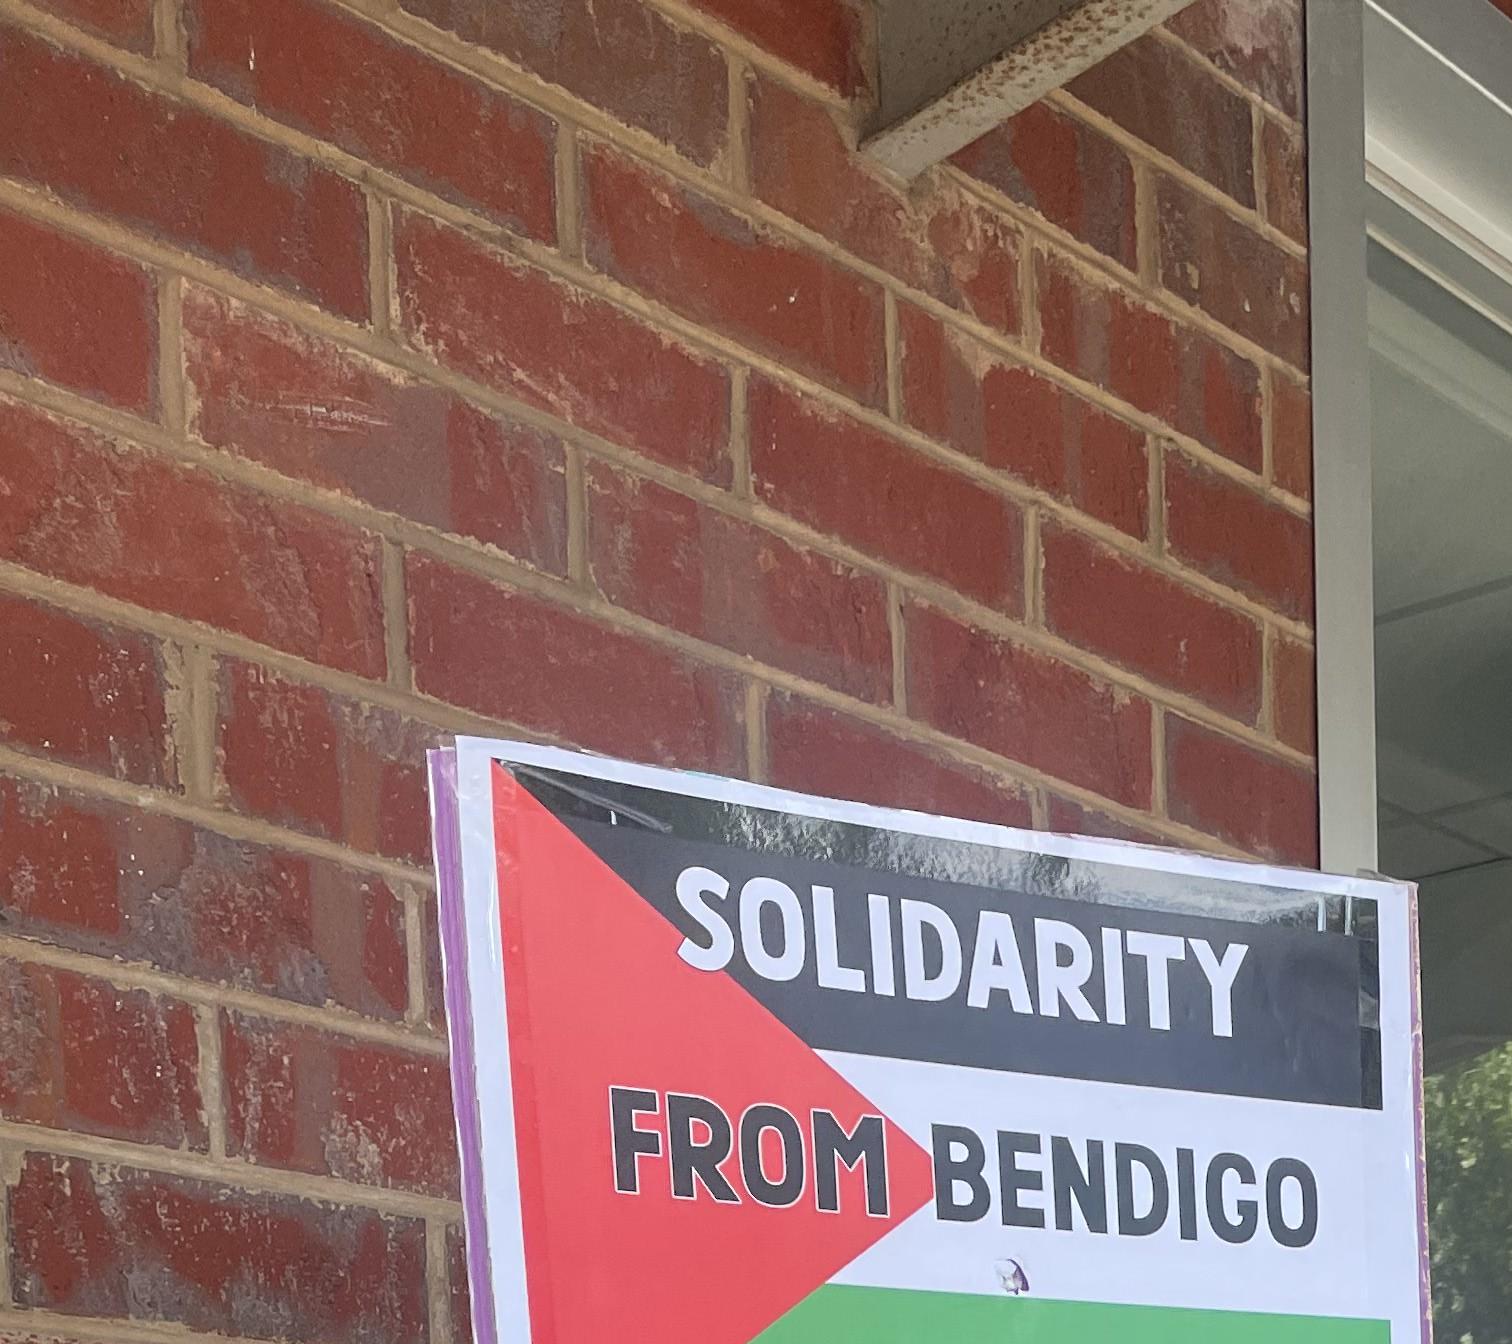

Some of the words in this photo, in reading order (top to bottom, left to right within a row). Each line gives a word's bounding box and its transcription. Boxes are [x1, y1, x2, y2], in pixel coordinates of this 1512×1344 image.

[675, 866, 1249, 1038] SOLIDARITY
[607, 1087, 889, 1219] FROM
[929, 1124, 1318, 1249] BENDIGO
